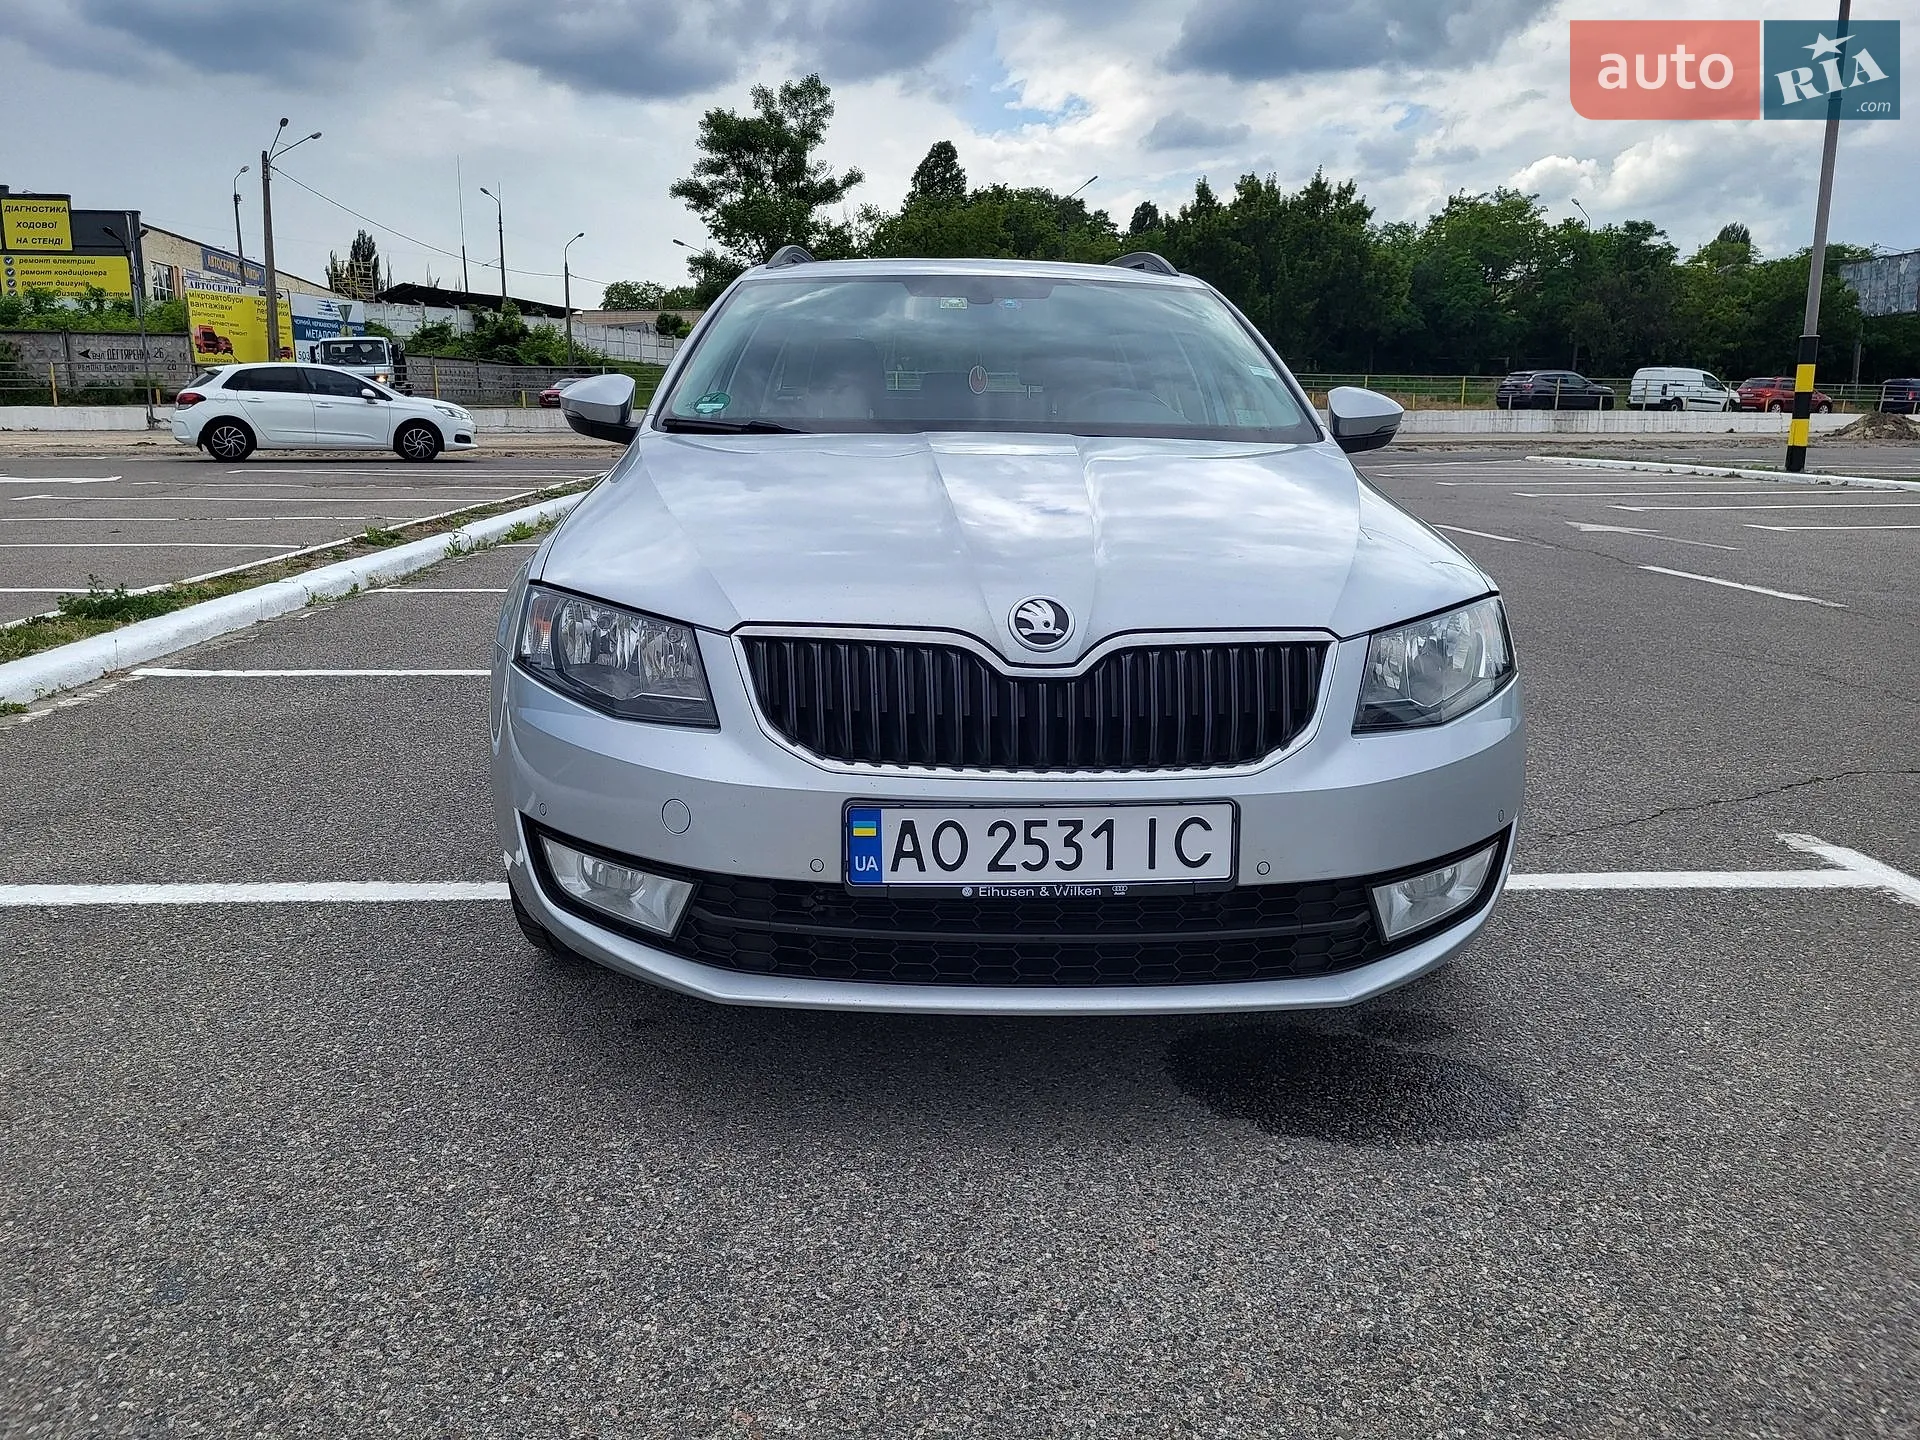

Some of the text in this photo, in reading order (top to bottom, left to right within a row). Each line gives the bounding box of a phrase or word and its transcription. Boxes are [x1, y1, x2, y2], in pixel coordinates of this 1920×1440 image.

[4, 205, 67, 213] ДІАГНОСТИКА
[16, 221, 57, 229] ХОДОВОЇ
[31, 238, 64, 246] СТЕНДІ
[19, 257, 50, 265] ремонт
[54, 269, 107, 277] кондиціонера
[189, 281, 243, 294] АВТОСЕРВІС
[188, 292, 244, 304] мікроавтобуси
[190, 301, 233, 311] вантажівки
[890, 816, 1213, 872] AO 2531 IC
[855, 856, 879, 872] UA
[1039, 887, 1050, 897] &
